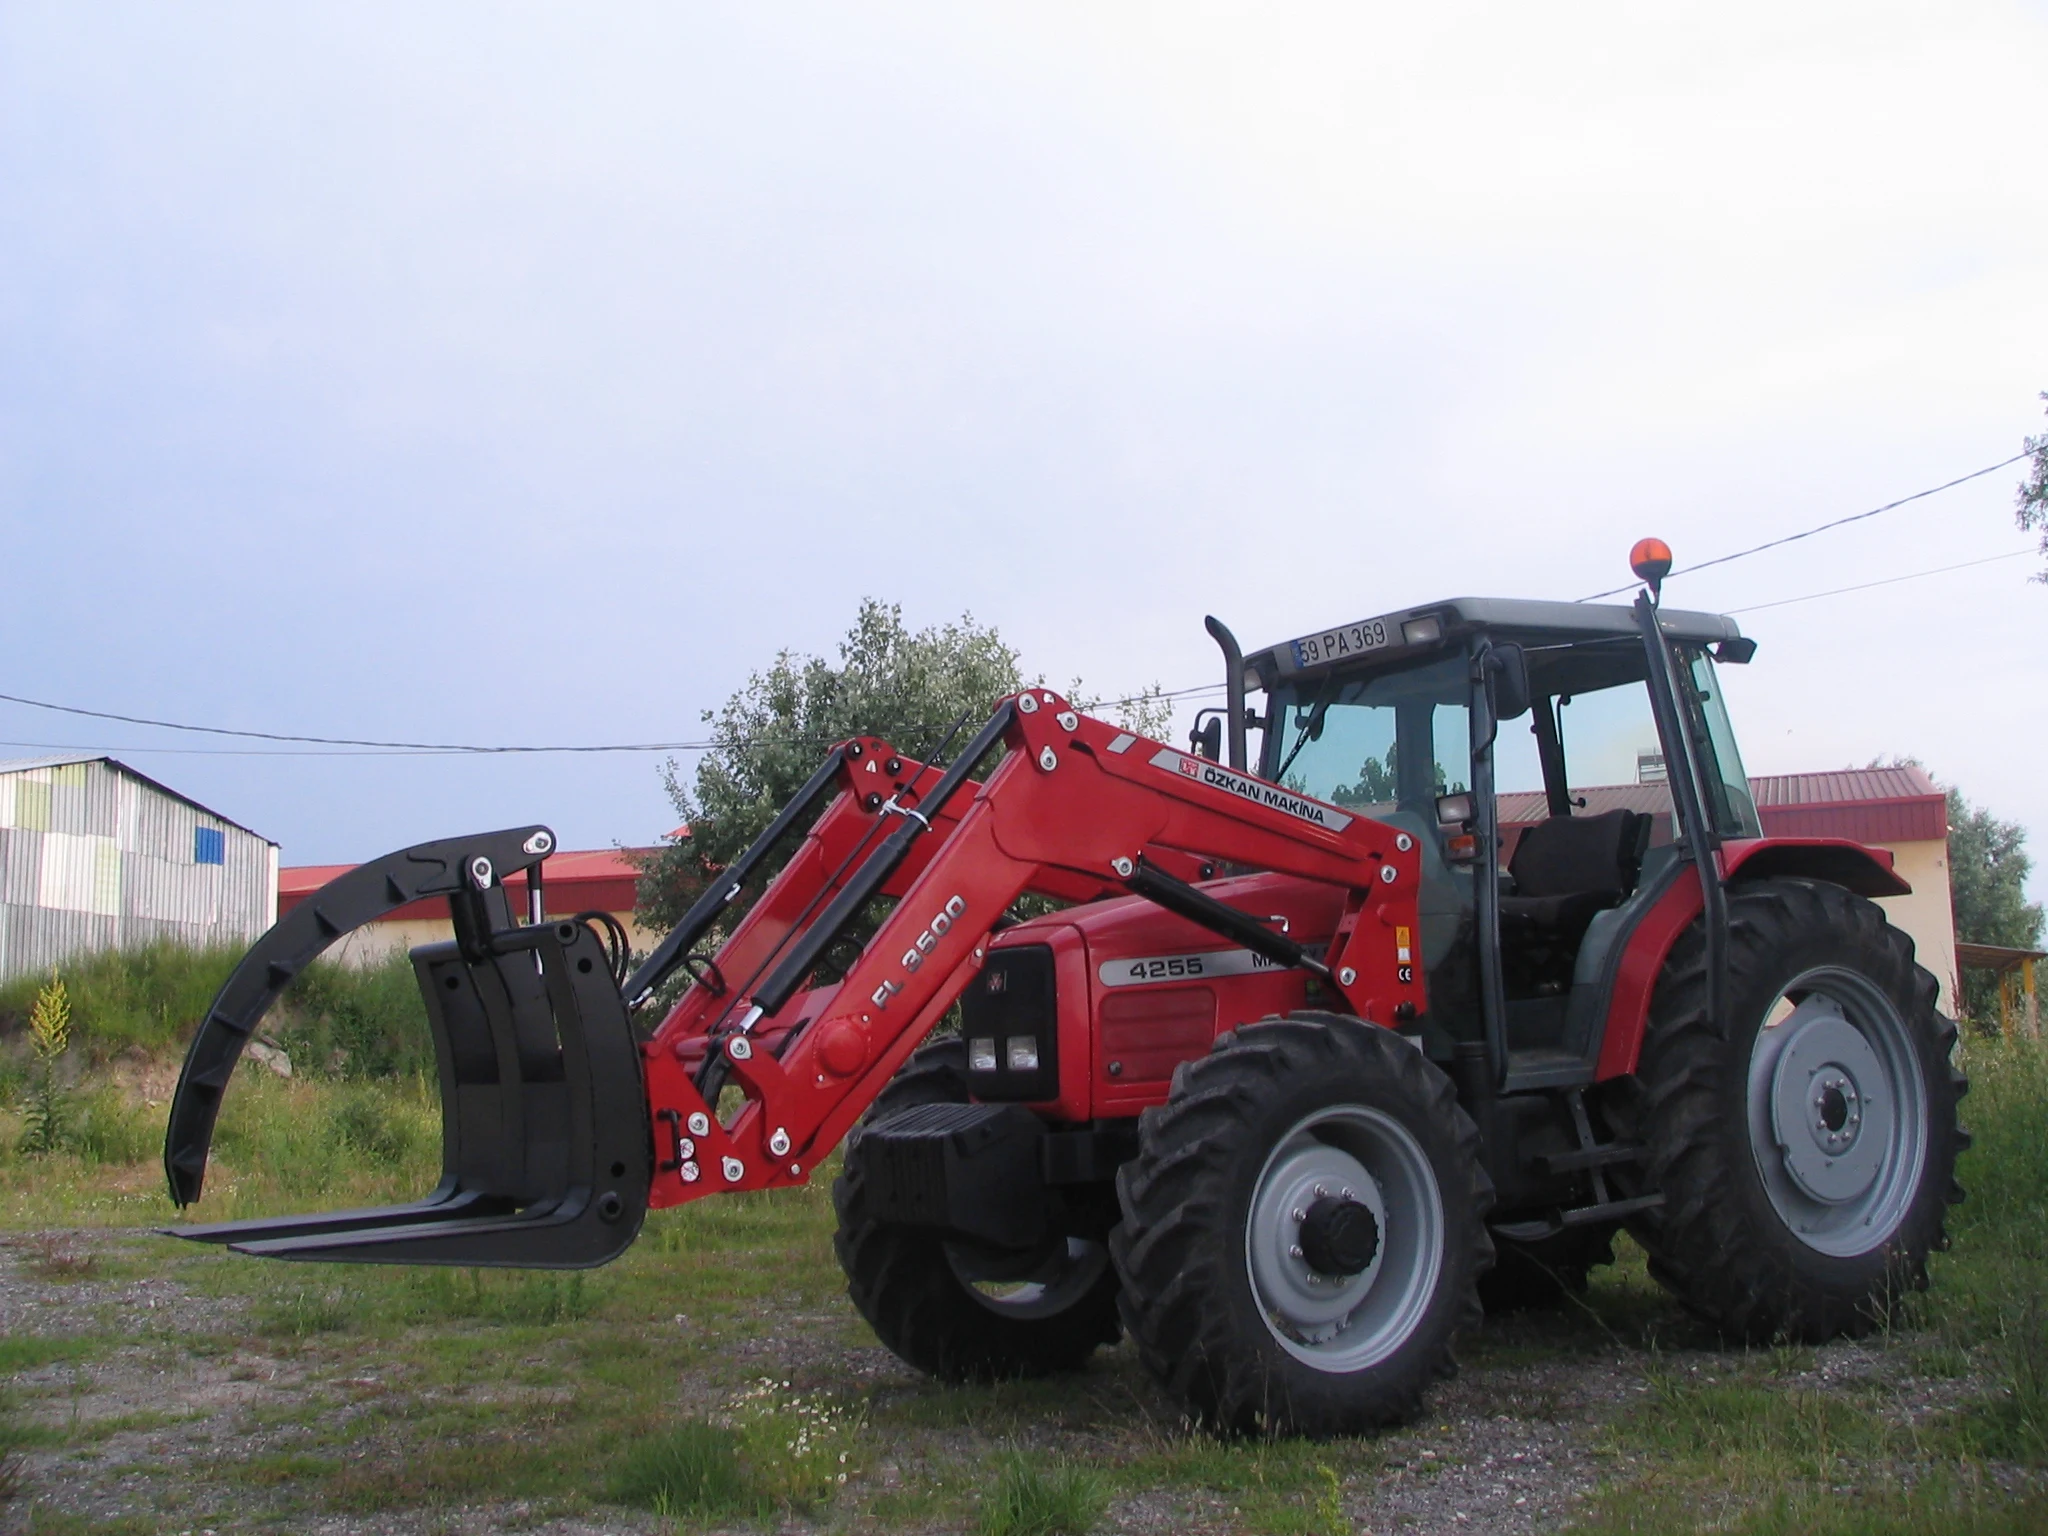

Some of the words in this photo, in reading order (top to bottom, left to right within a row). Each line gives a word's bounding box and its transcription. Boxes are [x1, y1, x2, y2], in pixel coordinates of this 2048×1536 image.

[1299, 640, 1319, 663] 59
[1323, 633, 1350, 658] PA
[1350, 622, 1386, 650] 369
[1204, 767, 1260, 800] ÖZKAN
[1263, 790, 1325, 824] MAKİNA
[871, 980, 904, 1010] FL
[901, 894, 967, 974] 3500
[1129, 957, 1203, 979] 4255
[1398, 968, 1411, 981] CE
